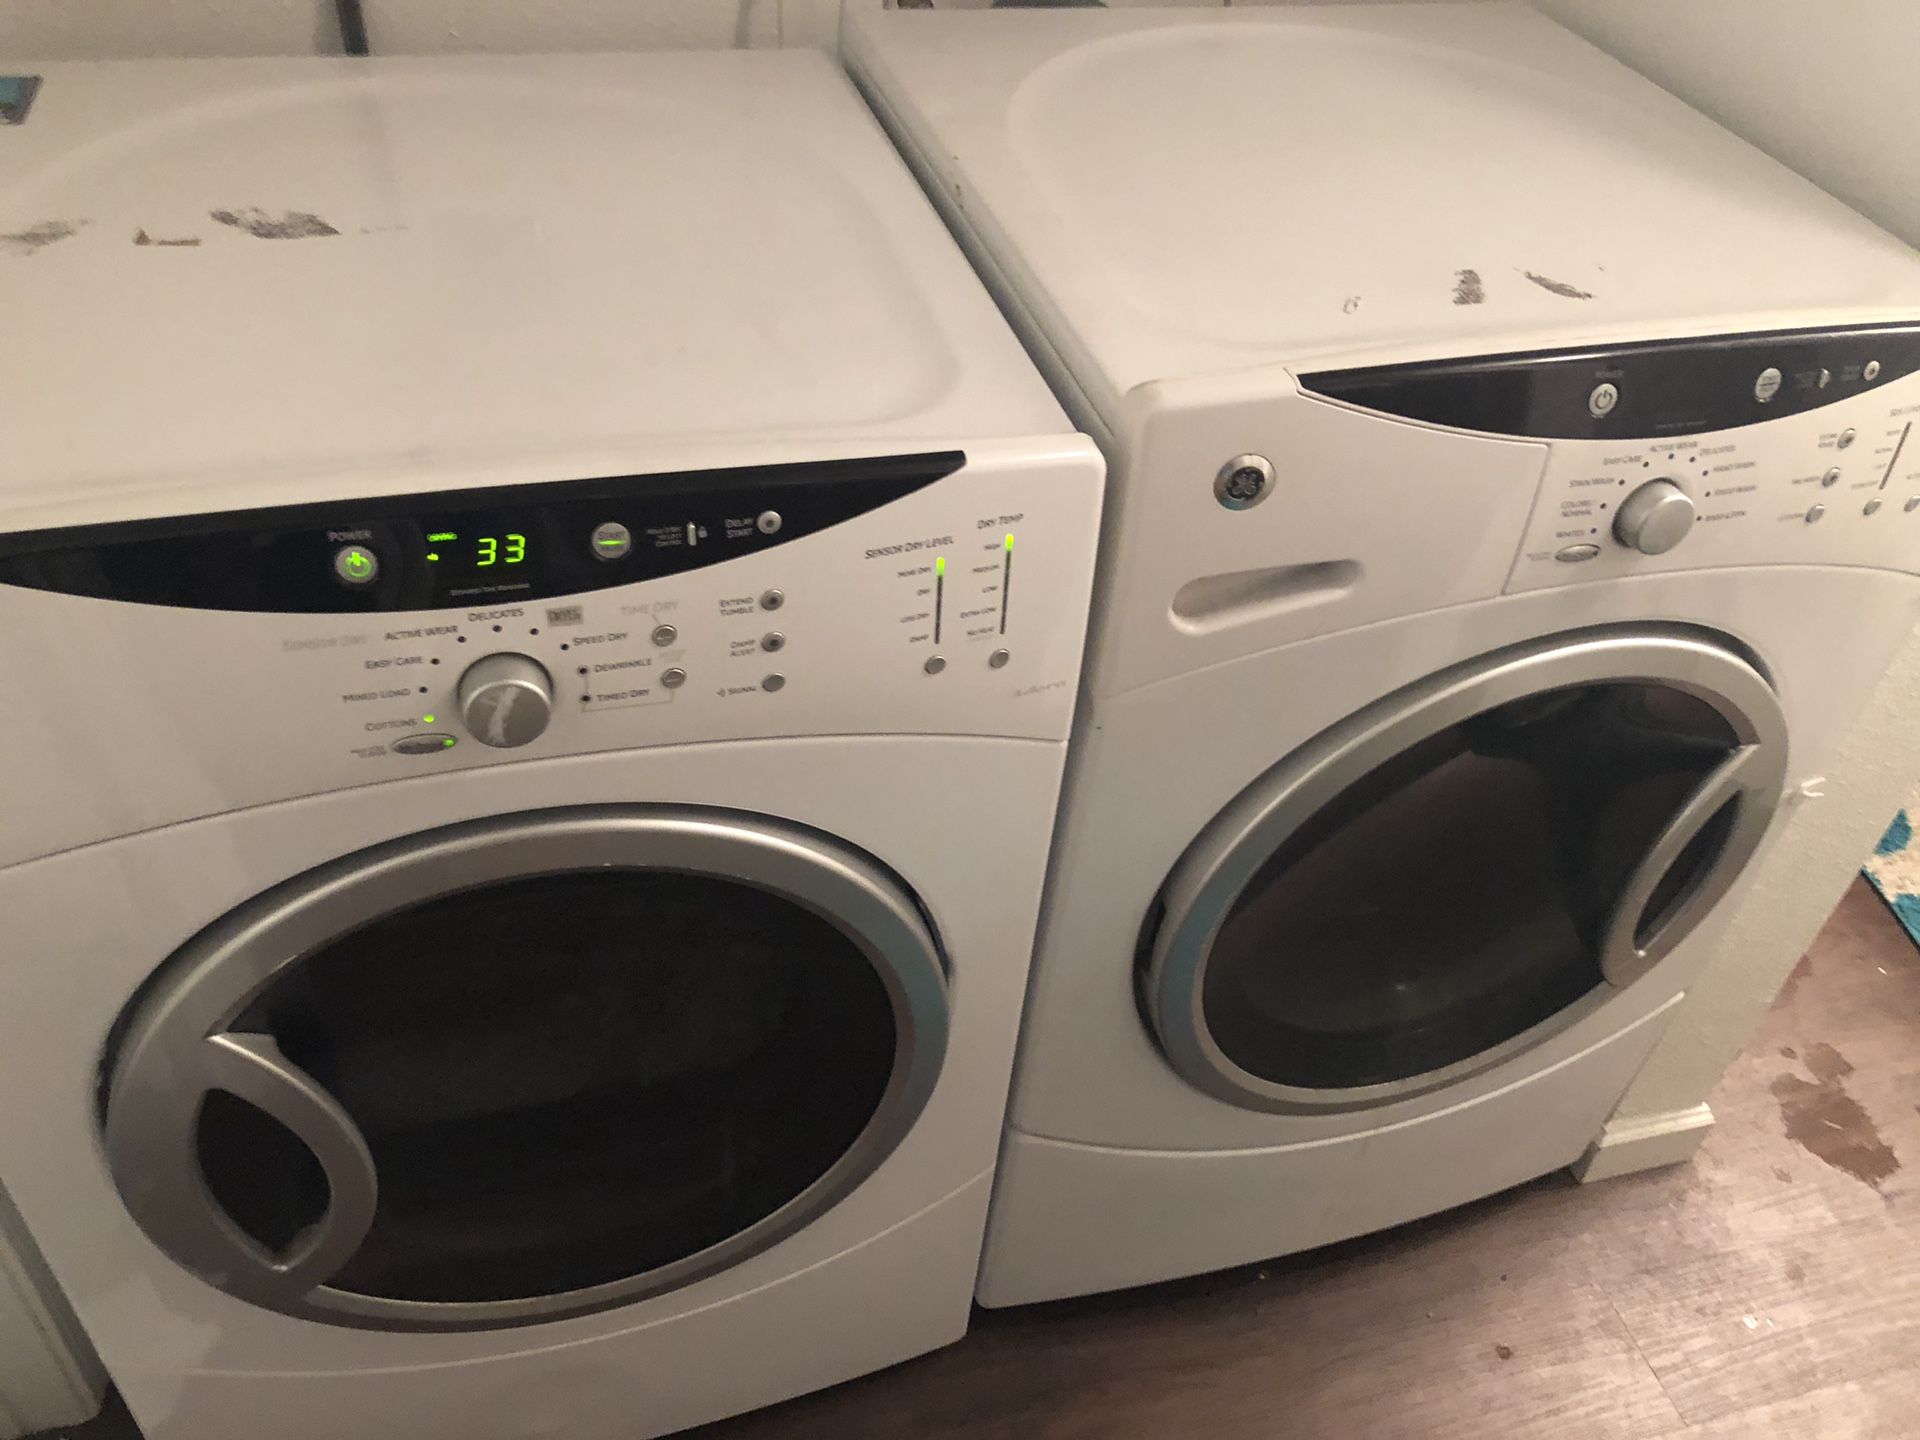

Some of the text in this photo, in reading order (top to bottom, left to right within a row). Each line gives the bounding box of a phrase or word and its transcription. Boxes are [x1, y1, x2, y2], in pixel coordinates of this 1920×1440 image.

[327, 529, 373, 543] POWER
[476, 533, 526, 566] 33
[467, 608, 525, 622] DELICATES
[384, 624, 459, 641] ACTIVE WEAR
[572, 632, 628, 647] SPEED DRY
[364, 655, 423, 670] EASY CARE
[594, 658, 653, 673] DEWRINKLE
[379, 687, 411, 699] LOAD
[596, 688, 650, 702] TIMED DRY
